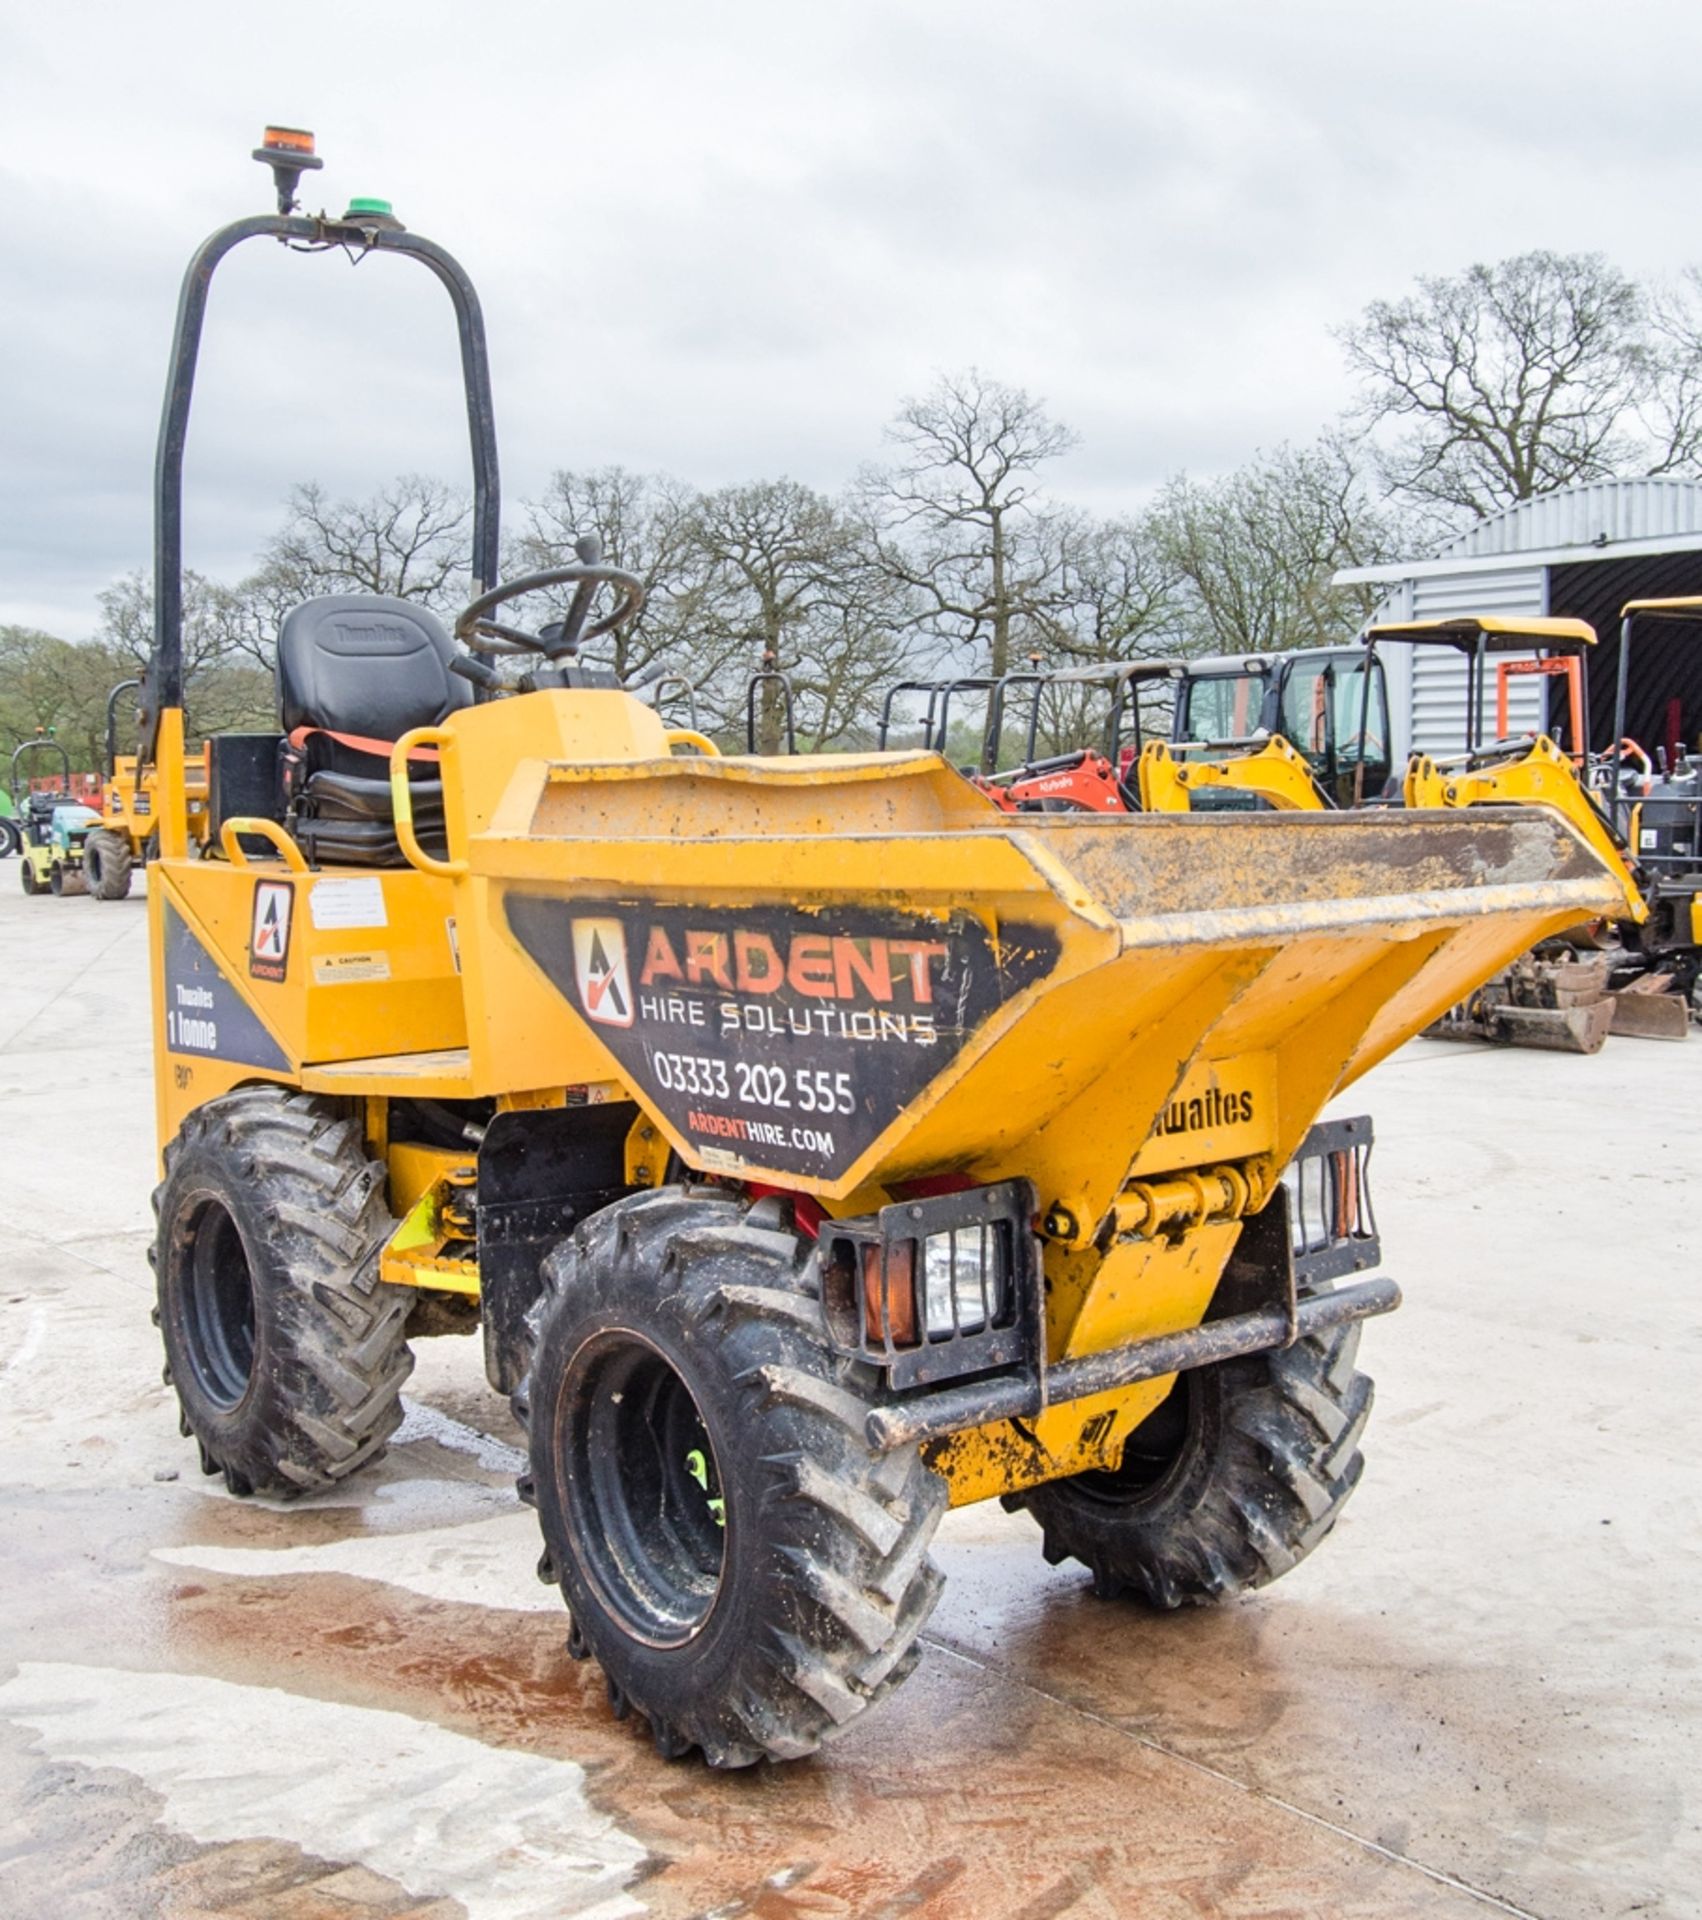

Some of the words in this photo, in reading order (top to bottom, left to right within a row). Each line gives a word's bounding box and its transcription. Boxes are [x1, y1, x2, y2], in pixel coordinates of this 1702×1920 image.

[639, 926, 946, 1002] ARDENT
[168, 1010, 176, 1045] 1
[640, 996, 706, 1026] HIRE
[720, 1002, 938, 1044] SOLUTIONS
[653, 1051, 730, 1099] 03333
[734, 1062, 791, 1109] 202
[796, 1070, 856, 1115] 555
[688, 1111, 836, 1155] ARDENTHIRE.COM
